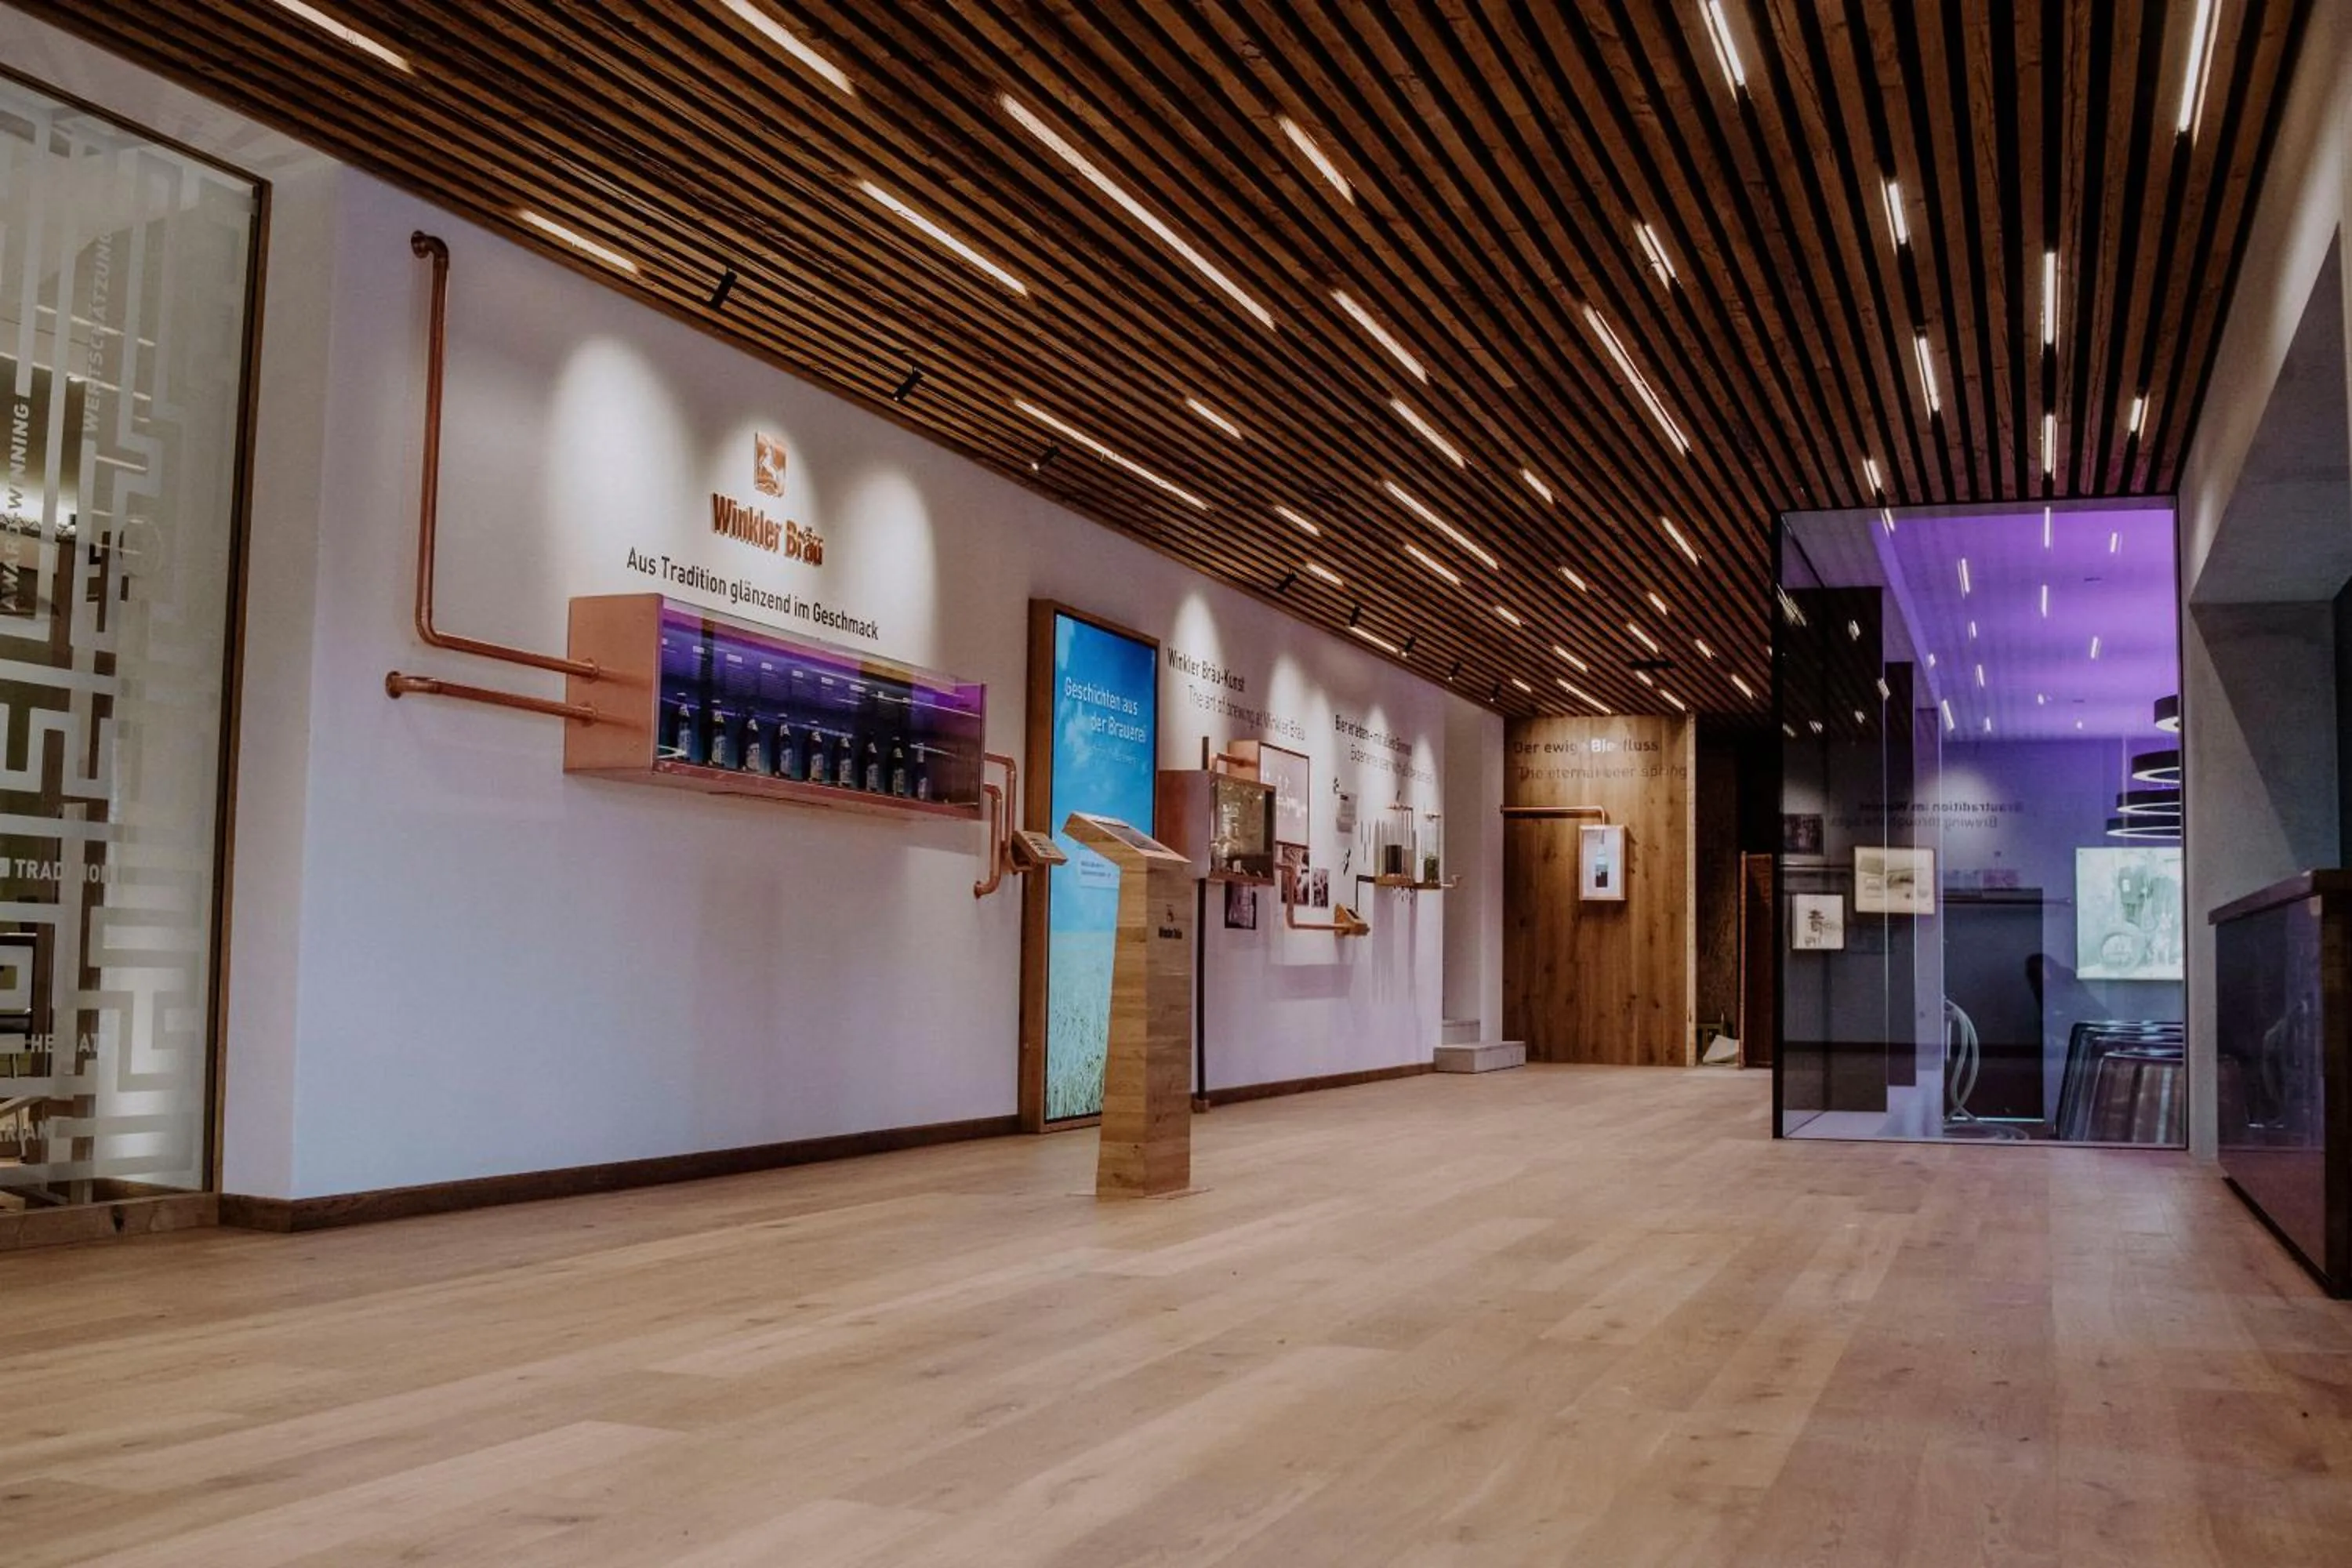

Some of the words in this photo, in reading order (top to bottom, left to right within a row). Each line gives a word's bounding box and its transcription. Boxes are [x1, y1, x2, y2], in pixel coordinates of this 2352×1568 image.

[711, 492, 781, 552] Winkler
[786, 519, 825, 567] Bräu
[626, 546, 657, 575] Aus
[661, 556, 728, 596] Tradition
[730, 579, 791, 613] glänzend
[794, 596, 810, 620] im
[812, 602, 879, 641] Geschmack
[1167, 647, 1200, 677] Winkler
[1065, 677, 1121, 712] Geschichten
[1123, 699, 1138, 716] aus
[1091, 715, 1106, 733] der
[1108, 716, 1146, 743] Brauerei
[1514, 739, 1539, 753] Der
[1639, 764, 1687, 780] spring
[31, 1033, 99, 1053] HEAT
